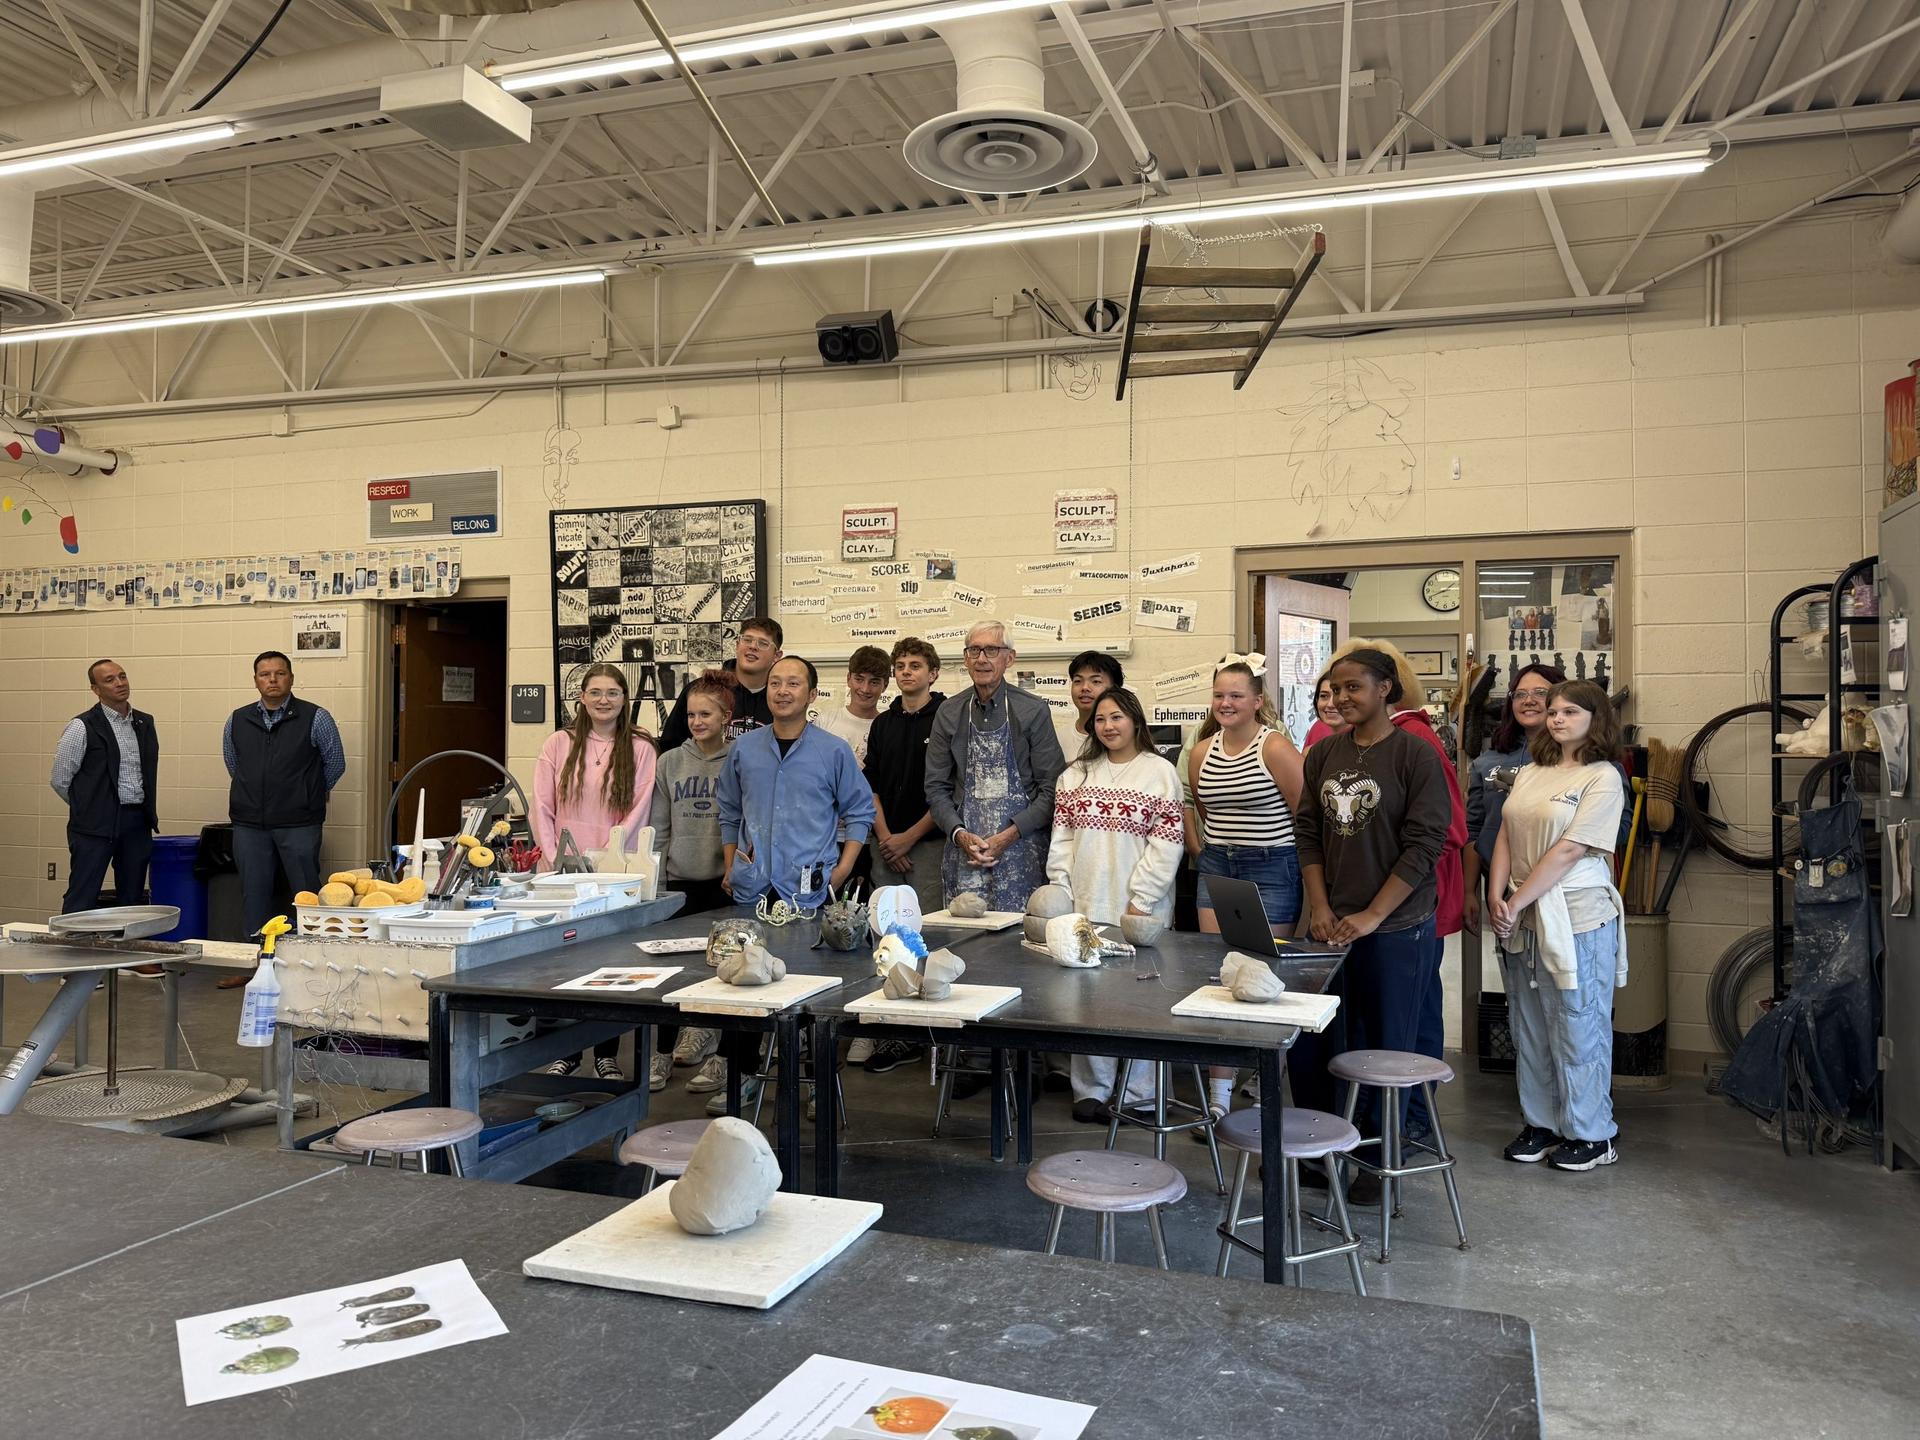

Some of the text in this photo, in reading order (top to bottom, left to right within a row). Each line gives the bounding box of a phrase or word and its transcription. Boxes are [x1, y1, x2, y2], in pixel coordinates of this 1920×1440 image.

[370, 485, 407, 496] RESPECT
[392, 509, 418, 518] WORK
[724, 506, 754, 517] LOOK
[1060, 506, 1106, 516] SCULPT
[453, 520, 490, 531] BELONG
[555, 521, 585, 529] commu
[621, 511, 651, 544] inspire
[734, 522, 743, 530] to
[847, 518, 887, 527] SCULPT
[1060, 533, 1090, 542] CLAY
[847, 545, 874, 553] CLAY
[621, 549, 652, 562] collab
[687, 548, 720, 565] Adapt
[589, 558, 620, 569] gather
[653, 558, 686, 575] create
[1028, 560, 1075, 570] neuroplasticity
[872, 563, 910, 576] SCORE
[1142, 561, 1196, 577] Juxtapose
[833, 585, 876, 594] greenware
[901, 581, 918, 594] slip
[687, 583, 720, 622] synthesize
[954, 592, 982, 606] relief
[589, 604, 620, 616] INVENT
[622, 606, 653, 615] subtract
[1074, 601, 1122, 621] SERIES
[1155, 604, 1183, 613] DART
[831, 614, 851, 622] bone
[854, 611, 866, 620] dry
[1015, 621, 1056, 630] extruder
[622, 626, 652, 636] Reloca
[852, 629, 896, 638] bisqueware
[559, 637, 590, 645] ANALYZE
[633, 648, 642, 658] te
[517, 688, 538, 697] J136
[1155, 708, 1209, 722] Ephemeral
